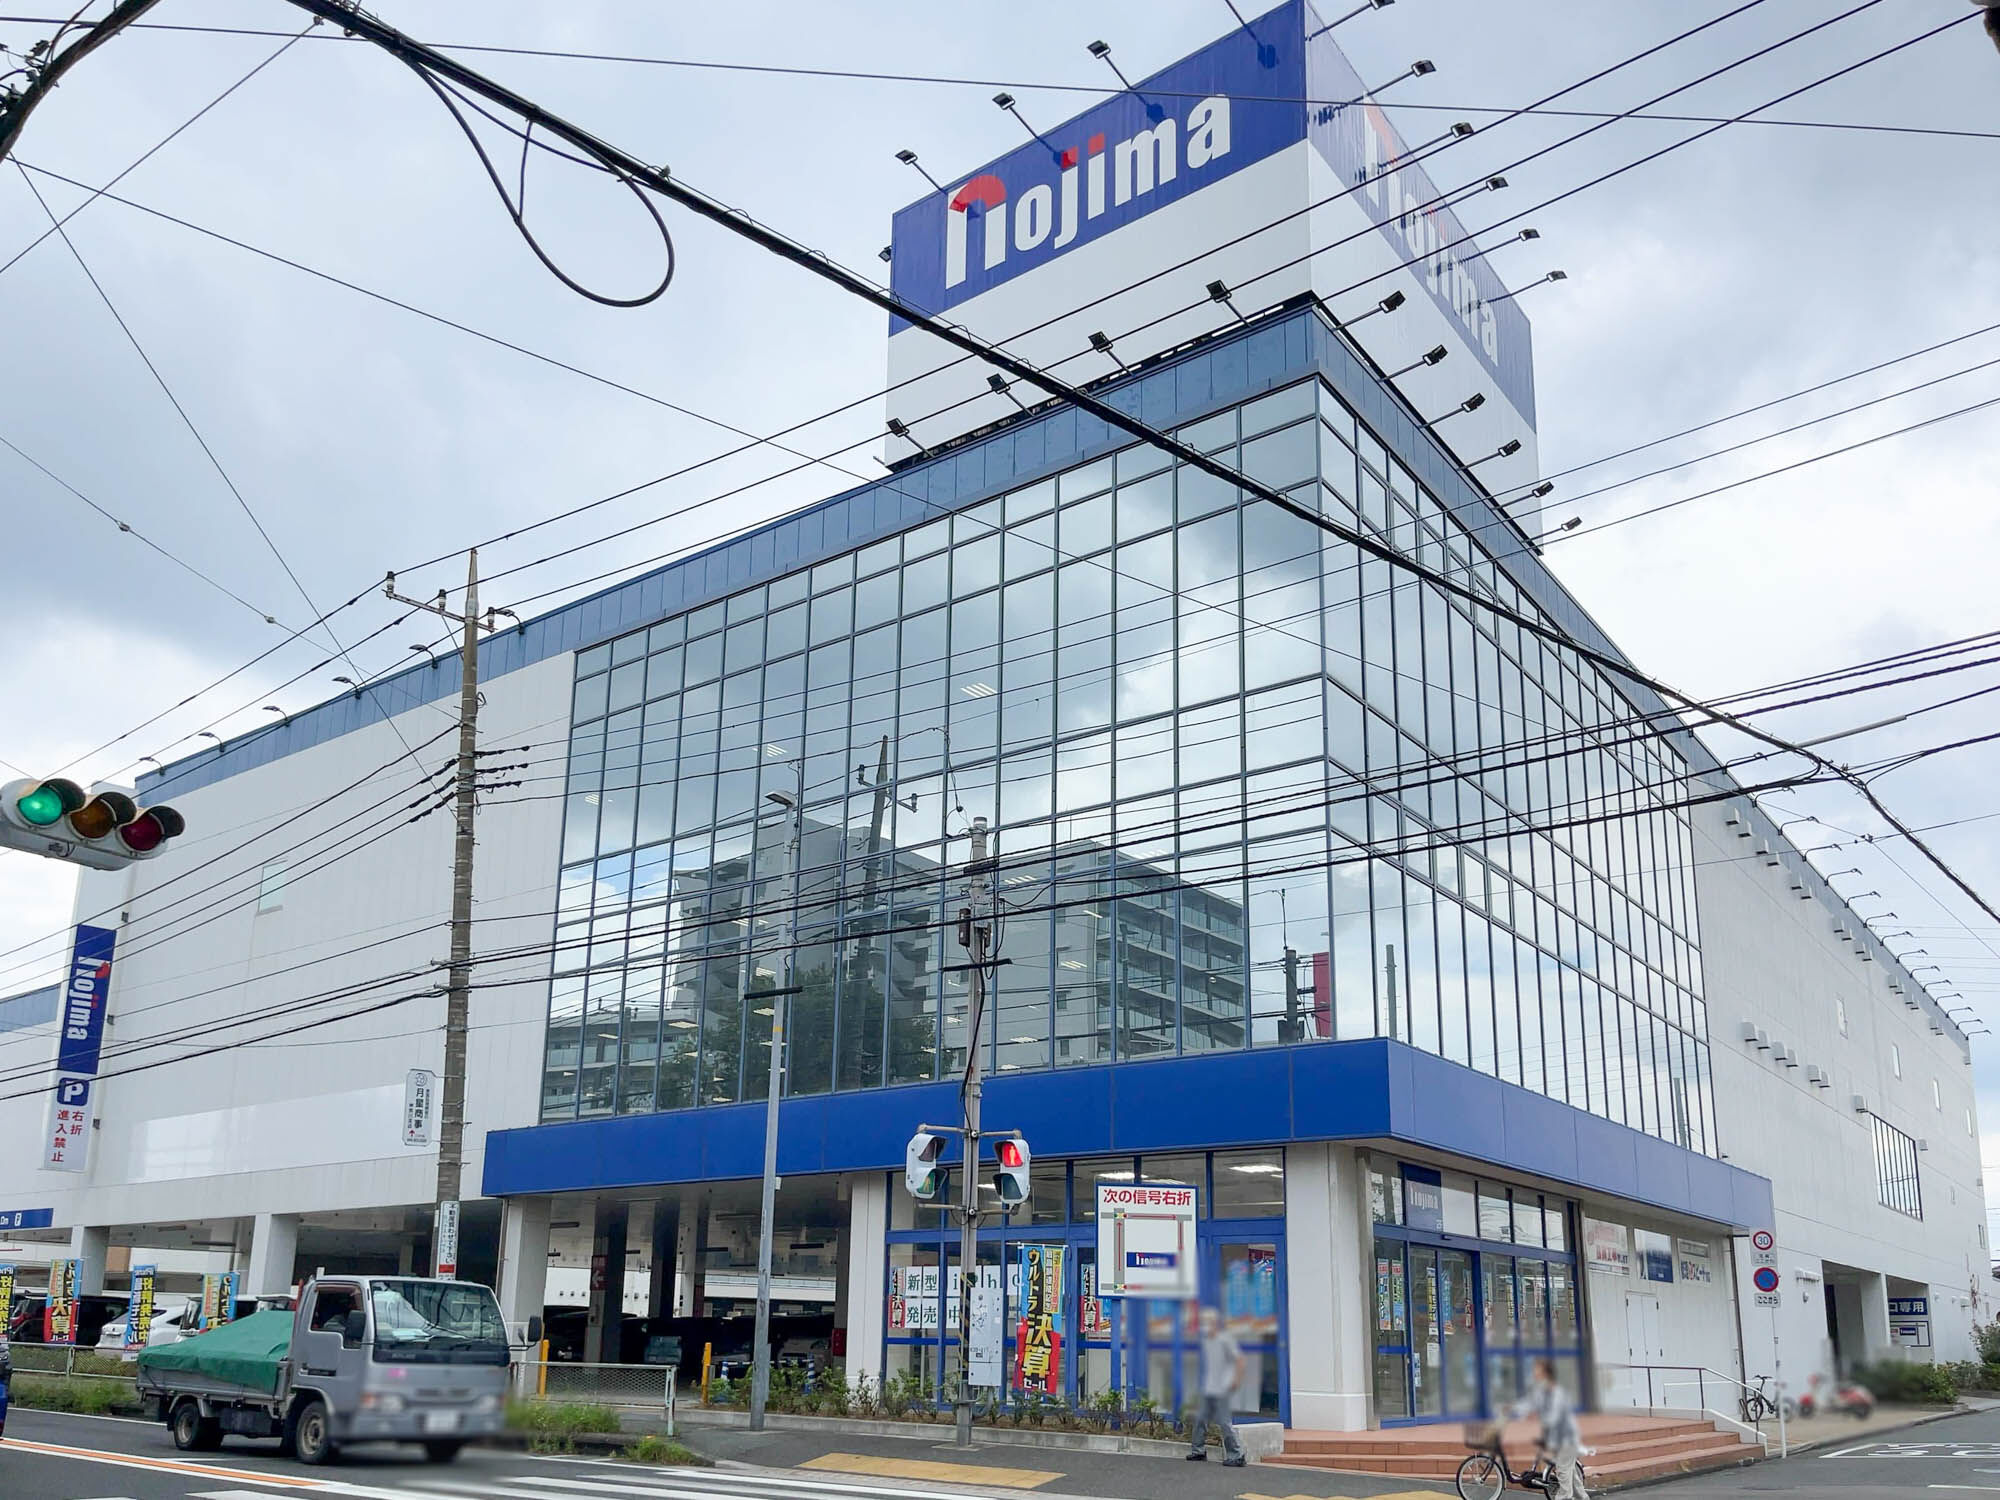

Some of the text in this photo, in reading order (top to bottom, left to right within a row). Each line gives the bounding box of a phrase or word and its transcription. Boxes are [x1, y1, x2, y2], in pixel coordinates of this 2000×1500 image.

[945, 94, 1231, 290] nojima
[1362, 91, 1499, 367] nojima
[66, 956, 112, 1041] nojima
[51, 1109, 70, 1162] 進入禁止
[70, 1110, 85, 1136] 右折
[1103, 1189, 1192, 1206] 次の信号右折
[1757, 1236, 1769, 1246] 30
[907, 1274, 937, 1292] 新型
[1757, 1295, 1779, 1305] ここから
[1021, 1249, 1053, 1378] ウルトラ決算
[1023, 1377, 1048, 1392] セール
